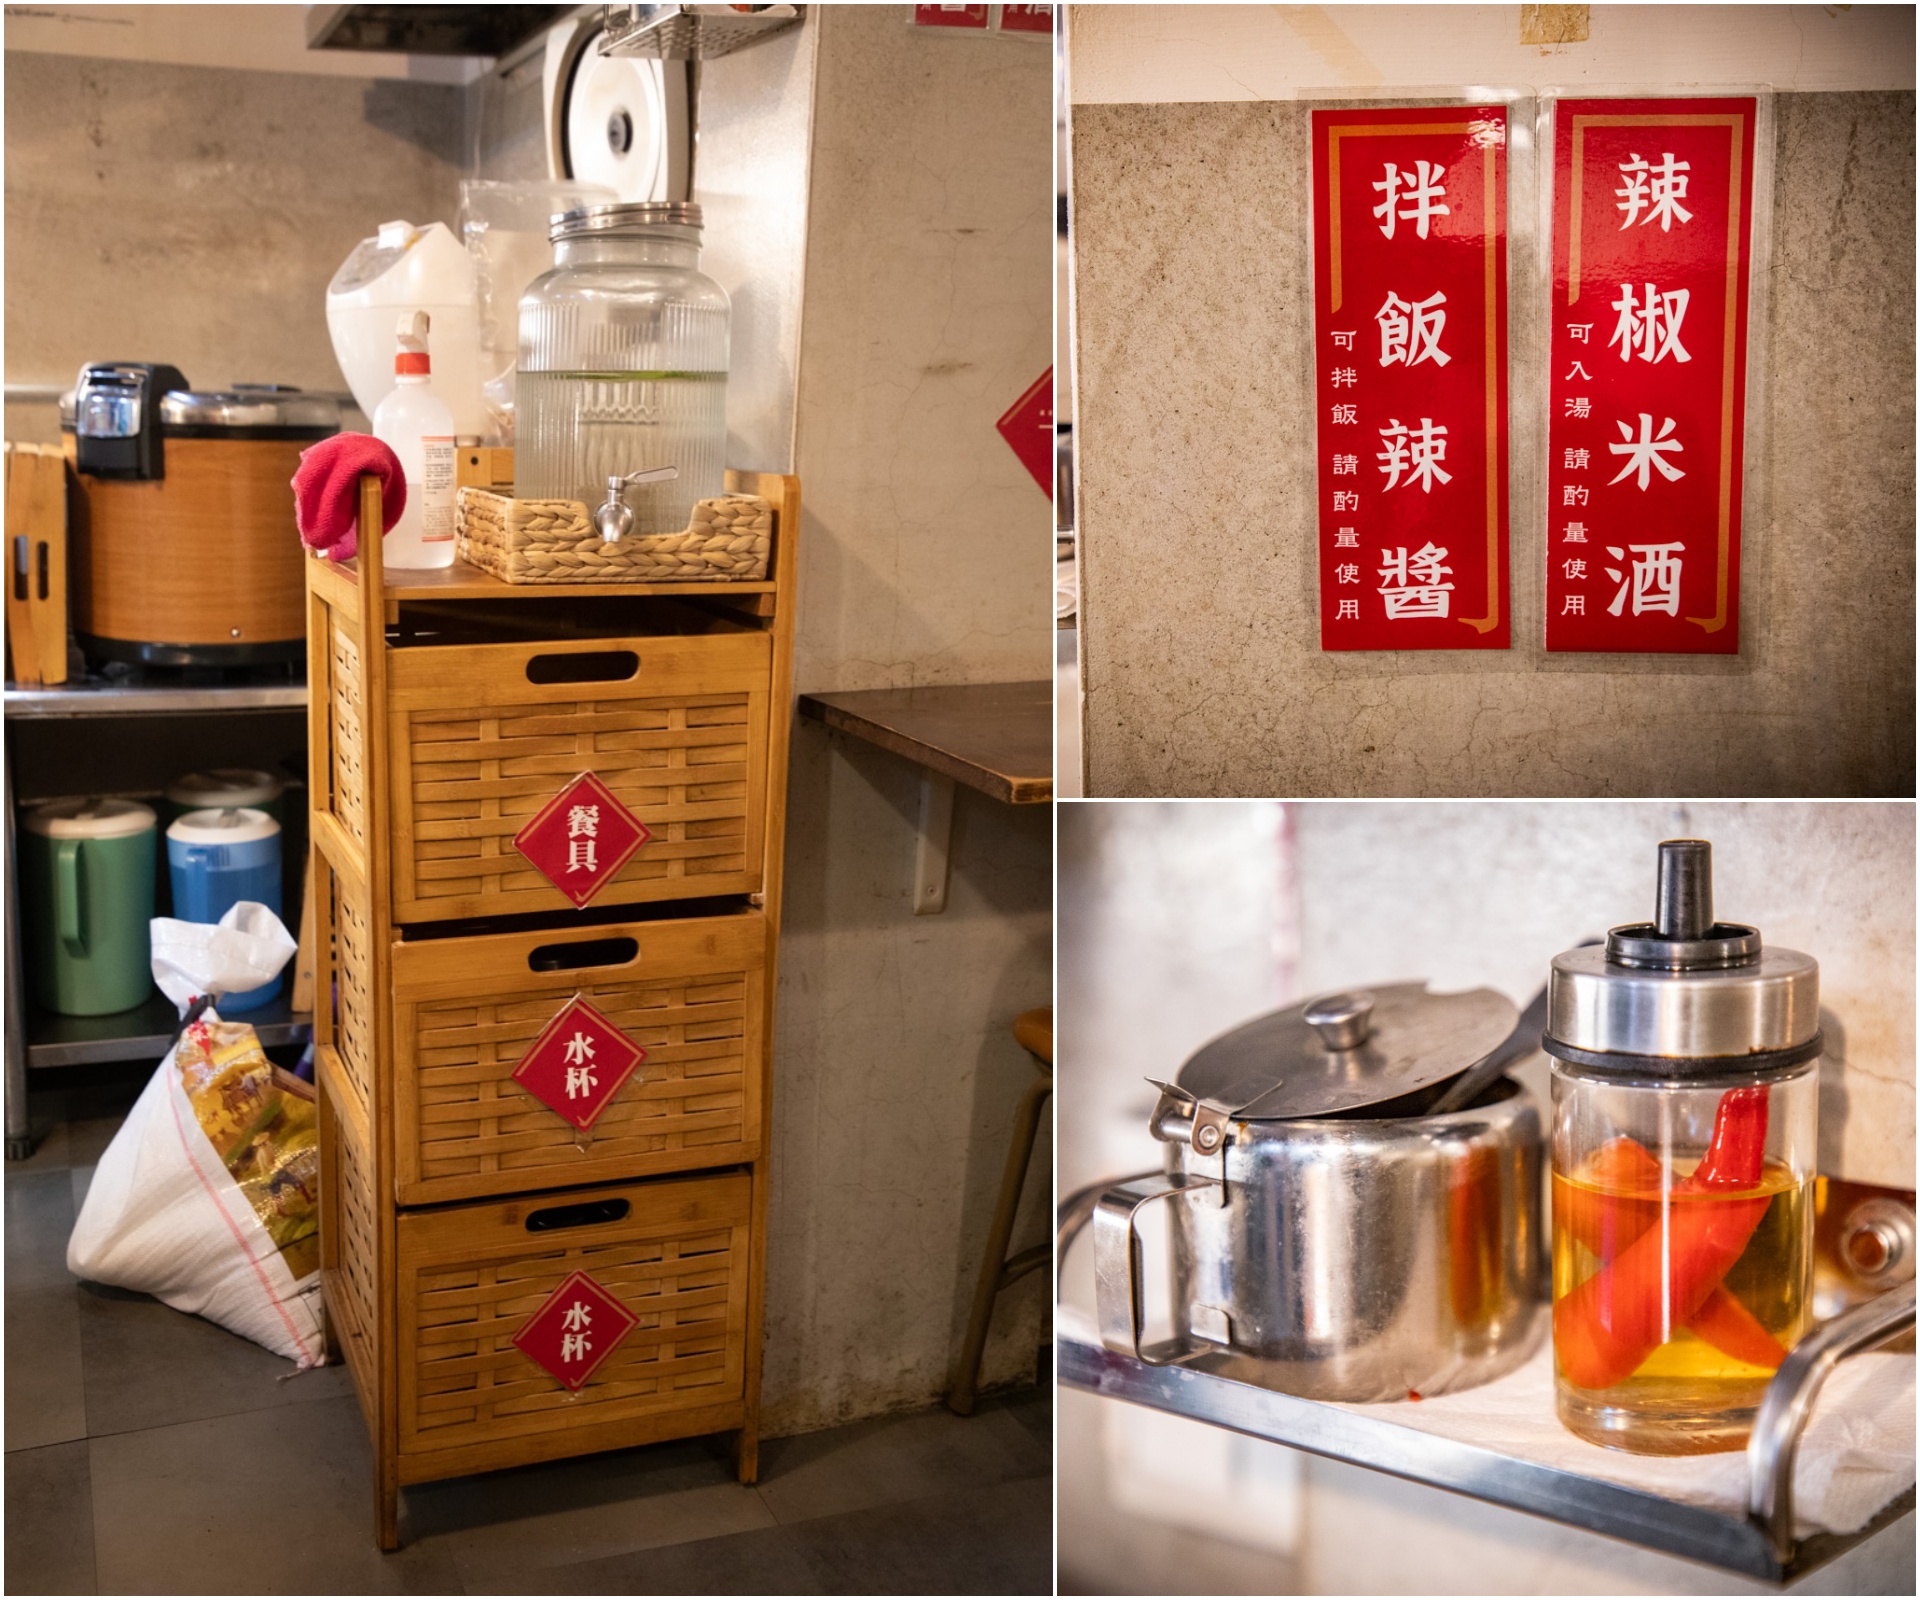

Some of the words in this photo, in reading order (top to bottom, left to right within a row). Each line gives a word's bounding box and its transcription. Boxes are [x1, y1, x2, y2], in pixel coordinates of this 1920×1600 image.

[1330, 330, 1358, 425] 可拌飯
[1372, 160, 1455, 620] 拌飯辣醬
[1565, 323, 1594, 419] 可入湯
[1604, 153, 1694, 617] 辣椒米酒
[1333, 454, 1360, 620] 請酌量使用
[1561, 448, 1590, 616] 請酌量使用
[566, 804, 600, 874] 餐具
[562, 1032, 599, 1100] 水杯
[560, 1301, 593, 1363] 水杯
